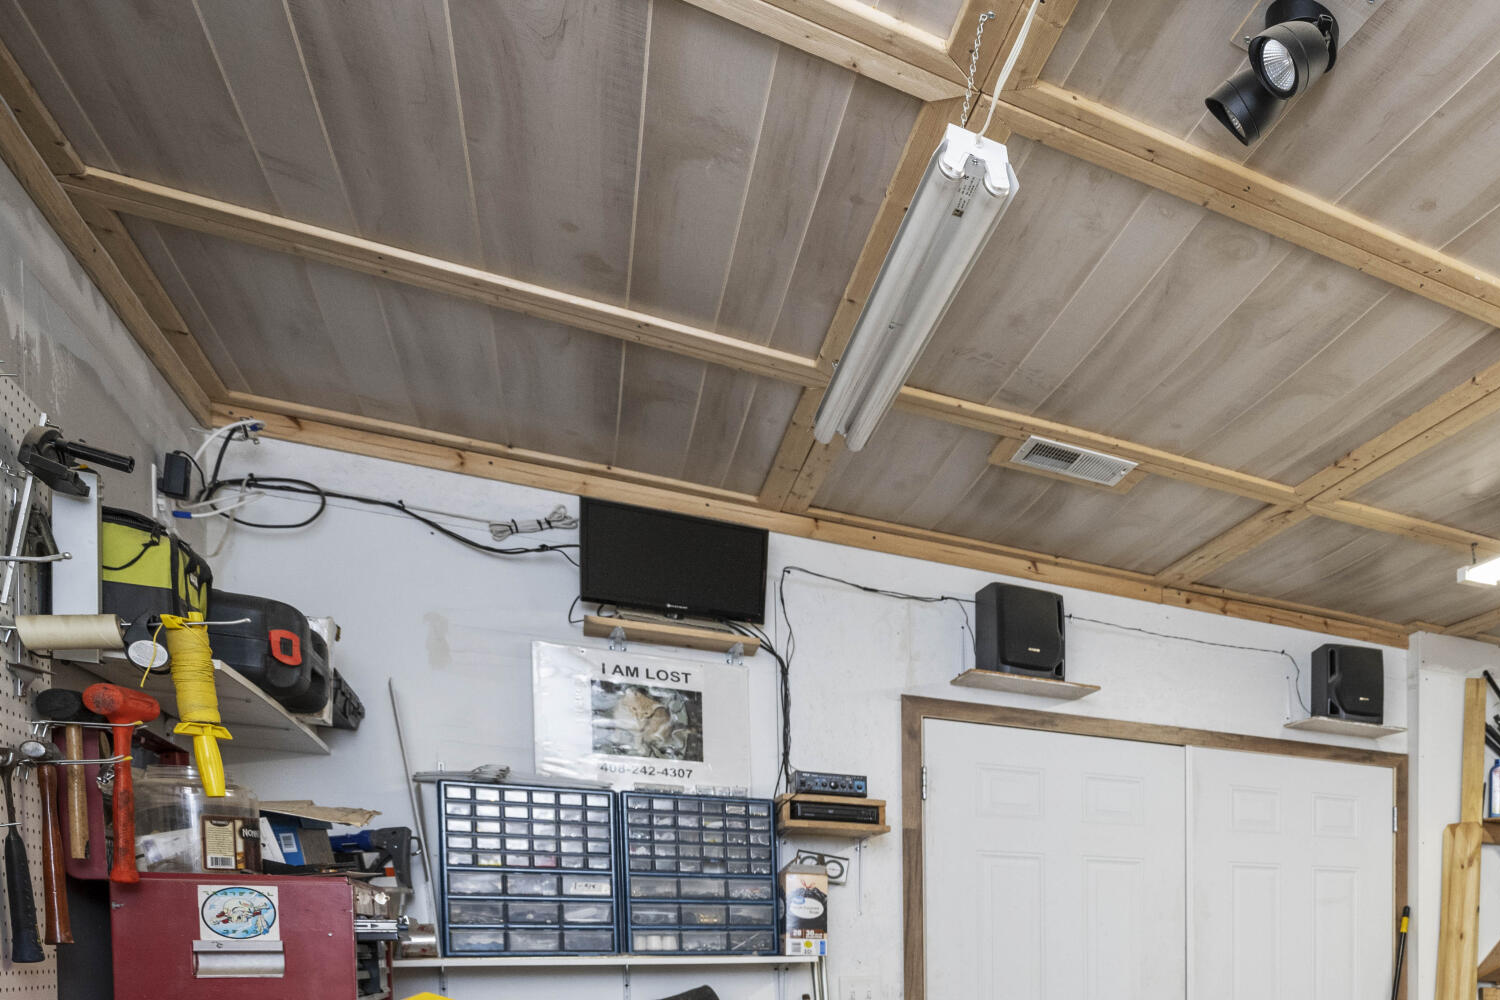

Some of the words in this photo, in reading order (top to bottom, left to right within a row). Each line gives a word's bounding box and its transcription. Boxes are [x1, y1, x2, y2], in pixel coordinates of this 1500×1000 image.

[600, 661, 606, 675] I
[611, 663, 640, 679] AM
[645, 667, 693, 685] LOST
